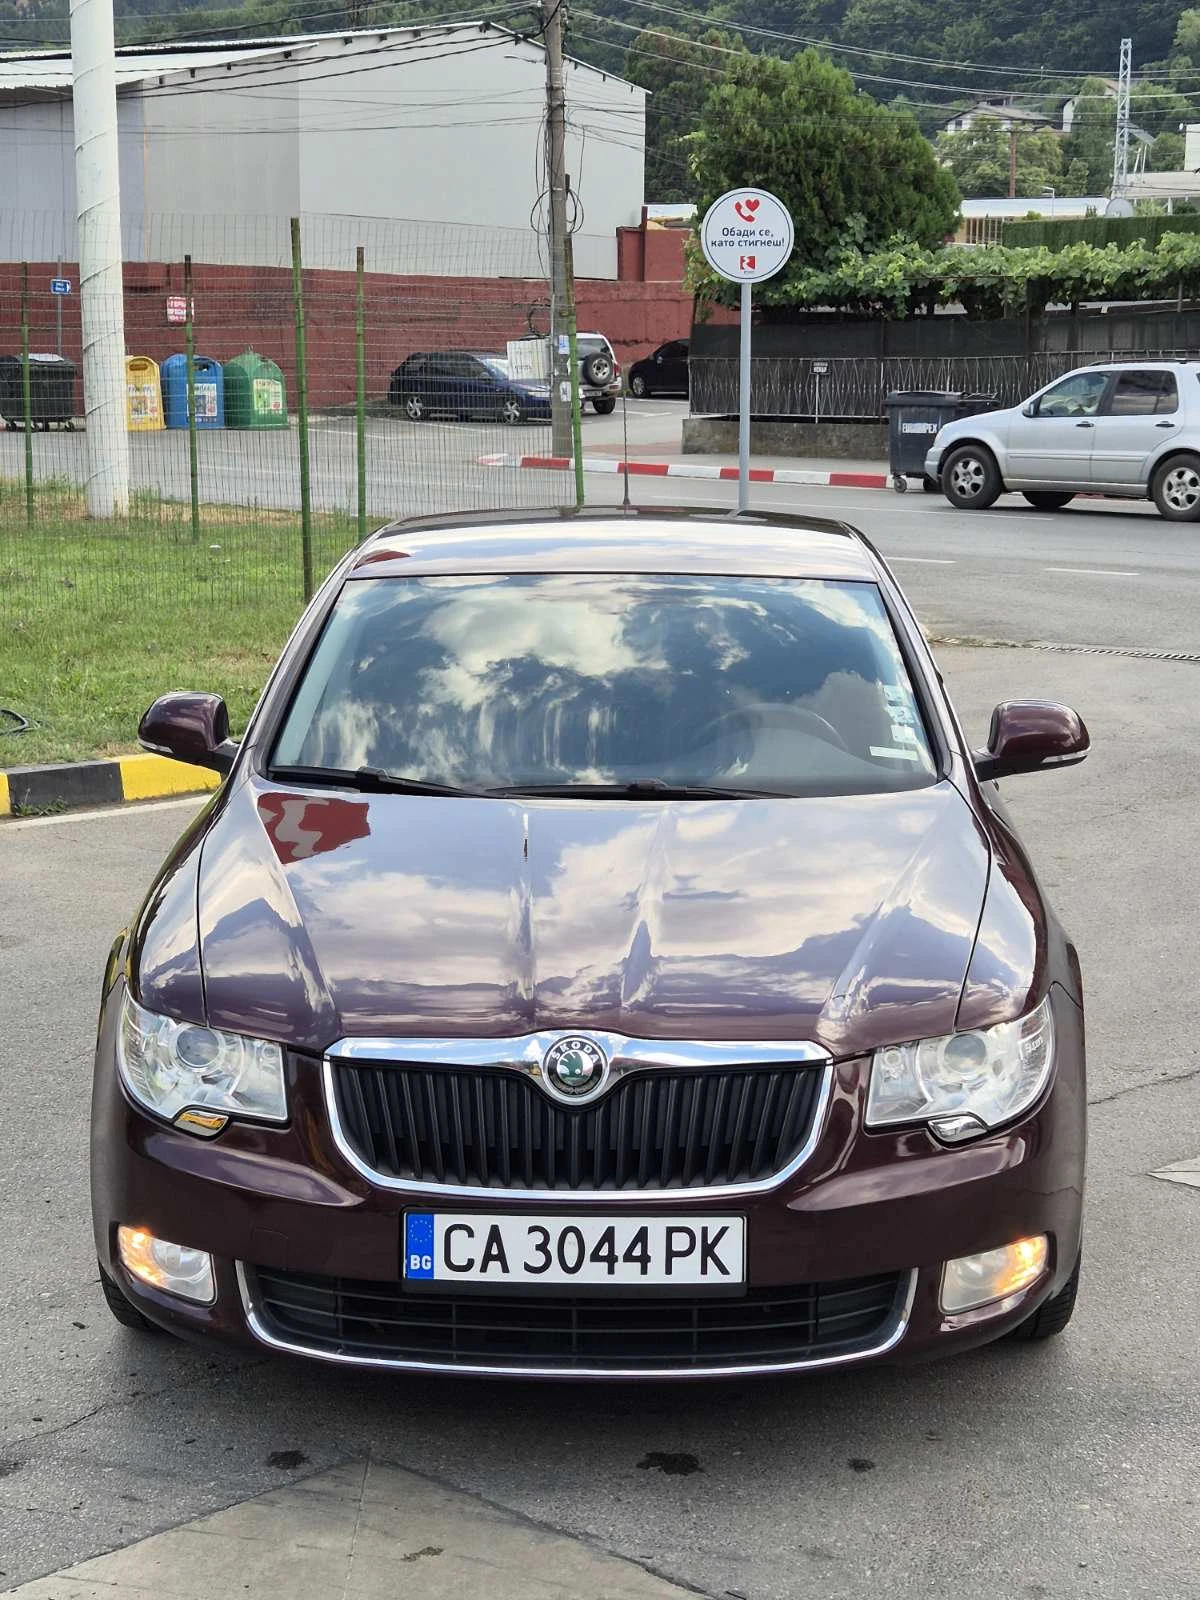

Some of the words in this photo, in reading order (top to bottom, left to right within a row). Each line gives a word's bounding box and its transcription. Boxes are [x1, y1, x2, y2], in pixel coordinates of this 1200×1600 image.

[722, 227, 755, 238] Обади
[759, 229, 773, 237] се,
[711, 239, 735, 247] като
[738, 237, 785, 247] стигнеш!
[444, 1223, 509, 1274] CA
[523, 1225, 651, 1275] 3044
[664, 1226, 730, 1275] PK
[409, 1254, 432, 1270] BG
